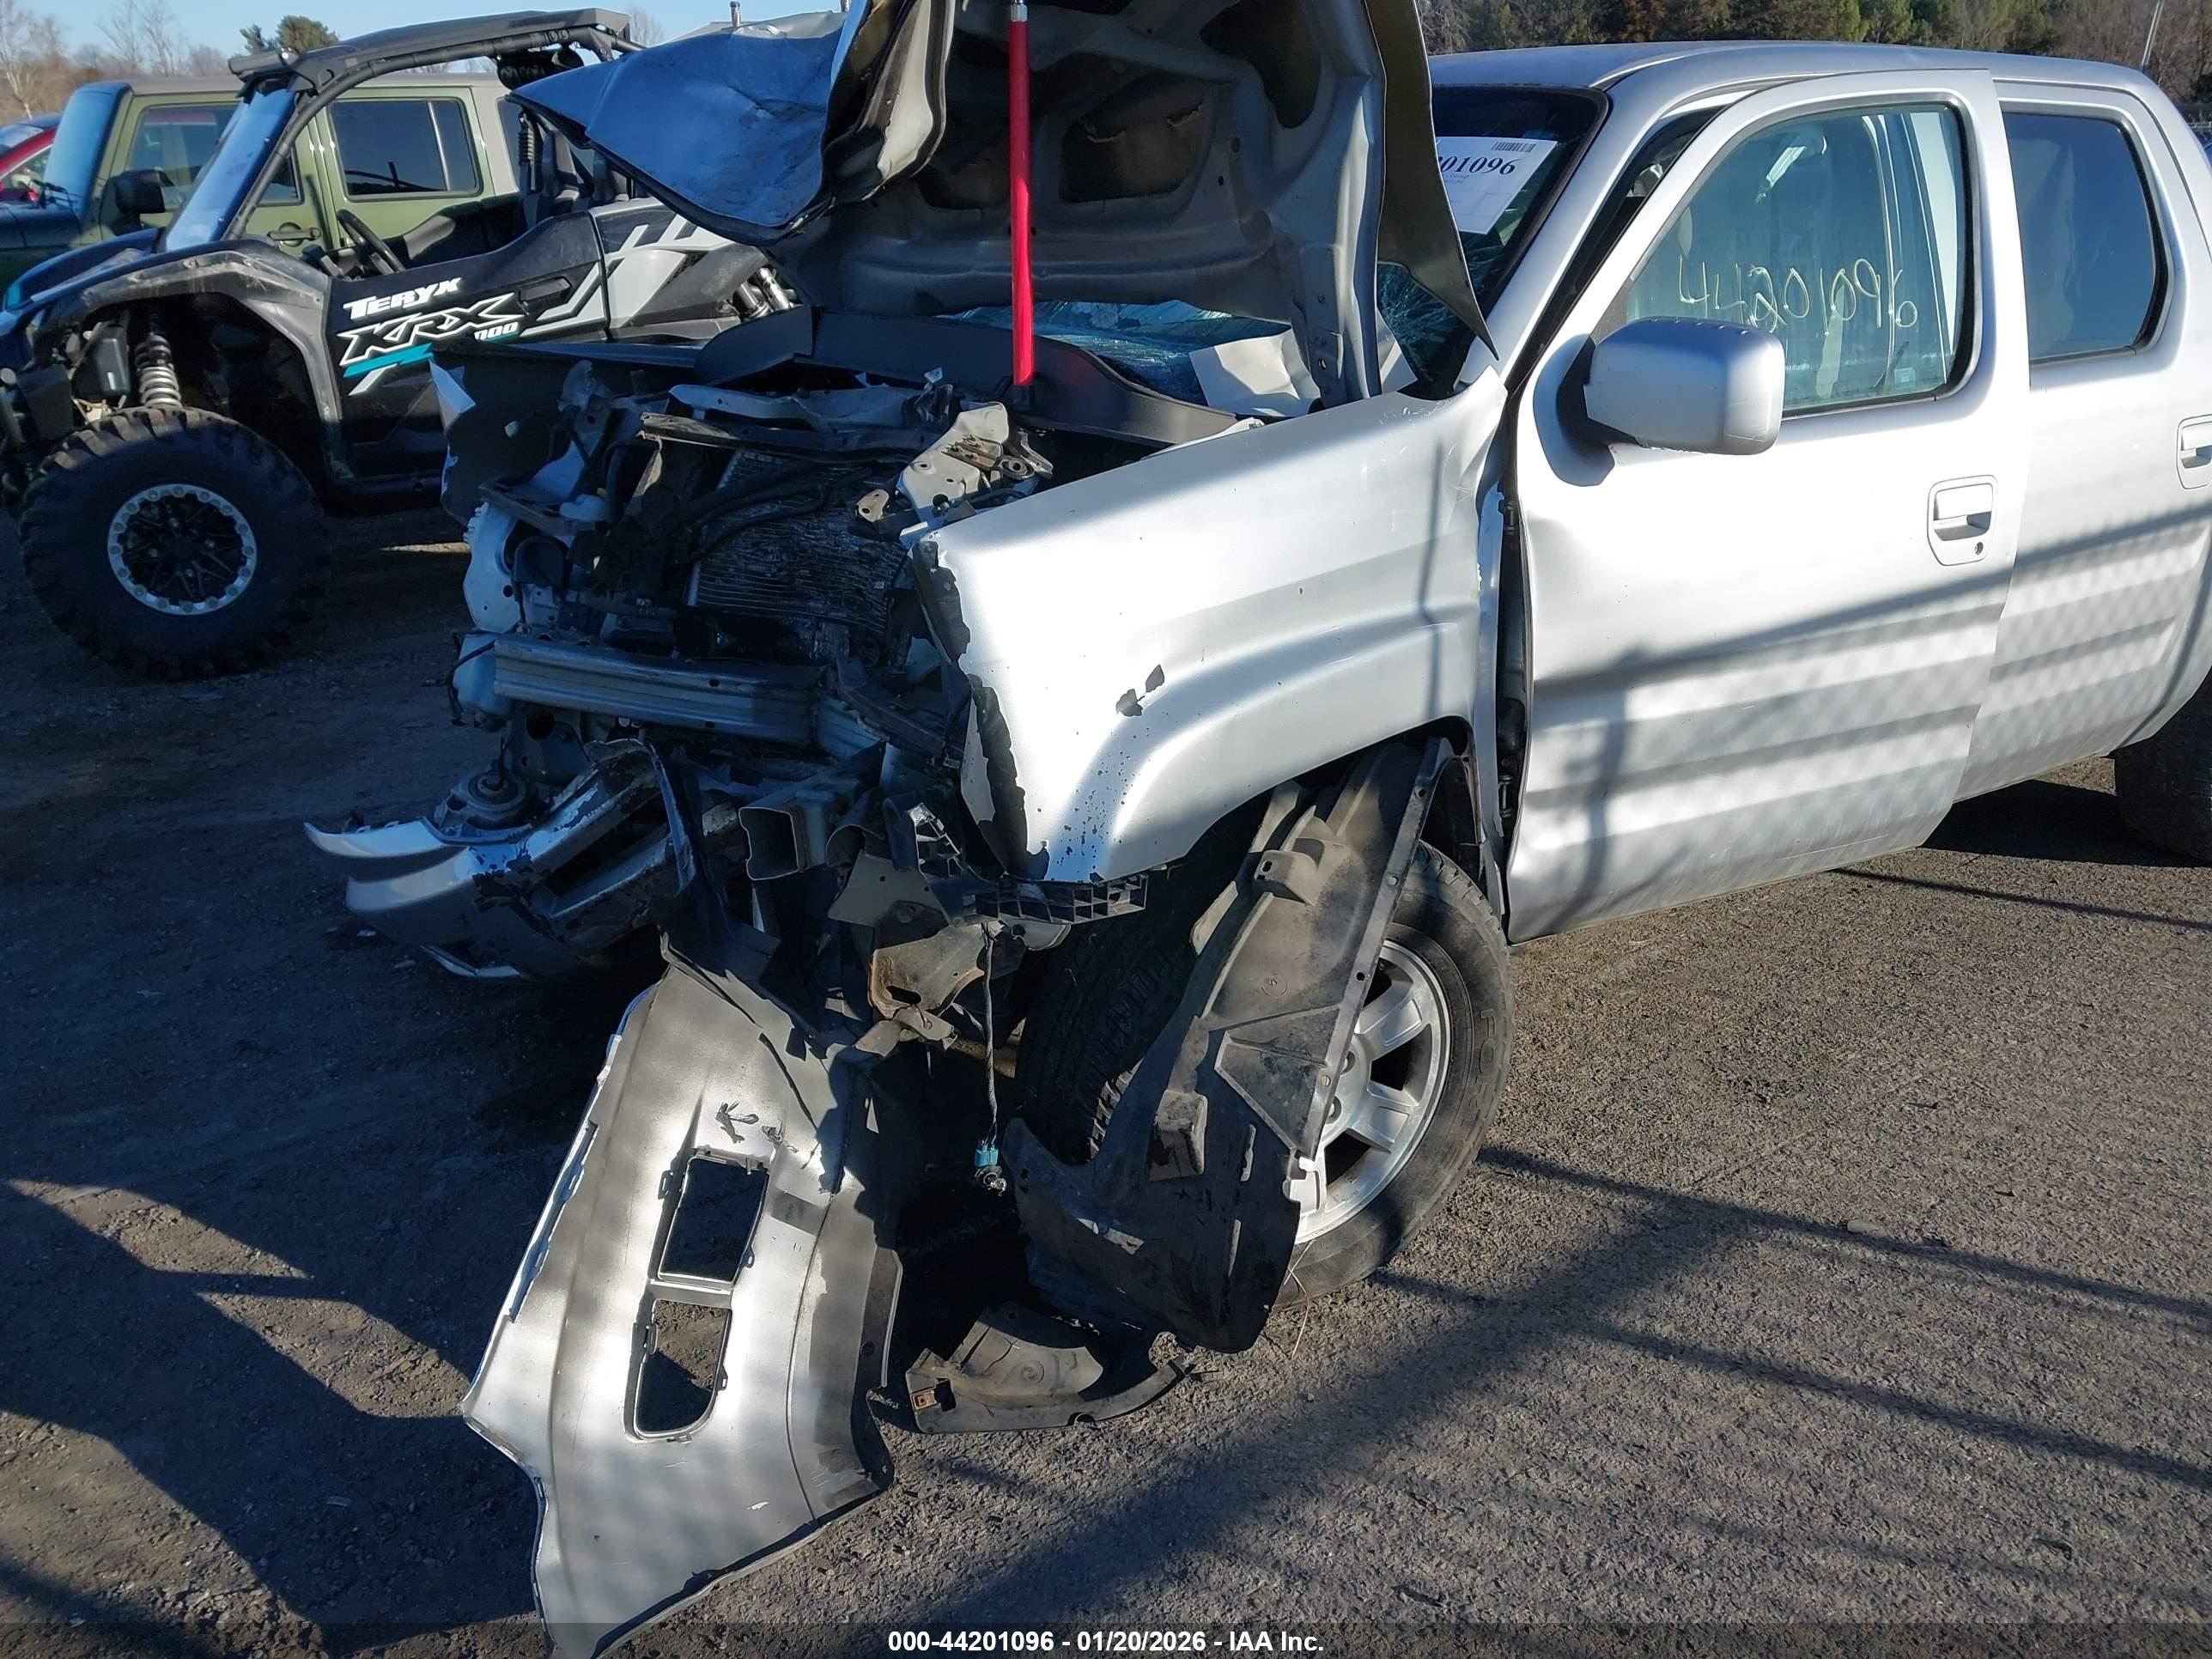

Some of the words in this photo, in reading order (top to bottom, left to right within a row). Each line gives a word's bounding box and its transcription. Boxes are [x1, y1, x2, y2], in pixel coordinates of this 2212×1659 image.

[1439, 155, 1522, 175] 01096
[343, 276, 462, 320] TERYX
[1678, 255, 1918, 335] 44201096
[336, 292, 525, 358] KRX
